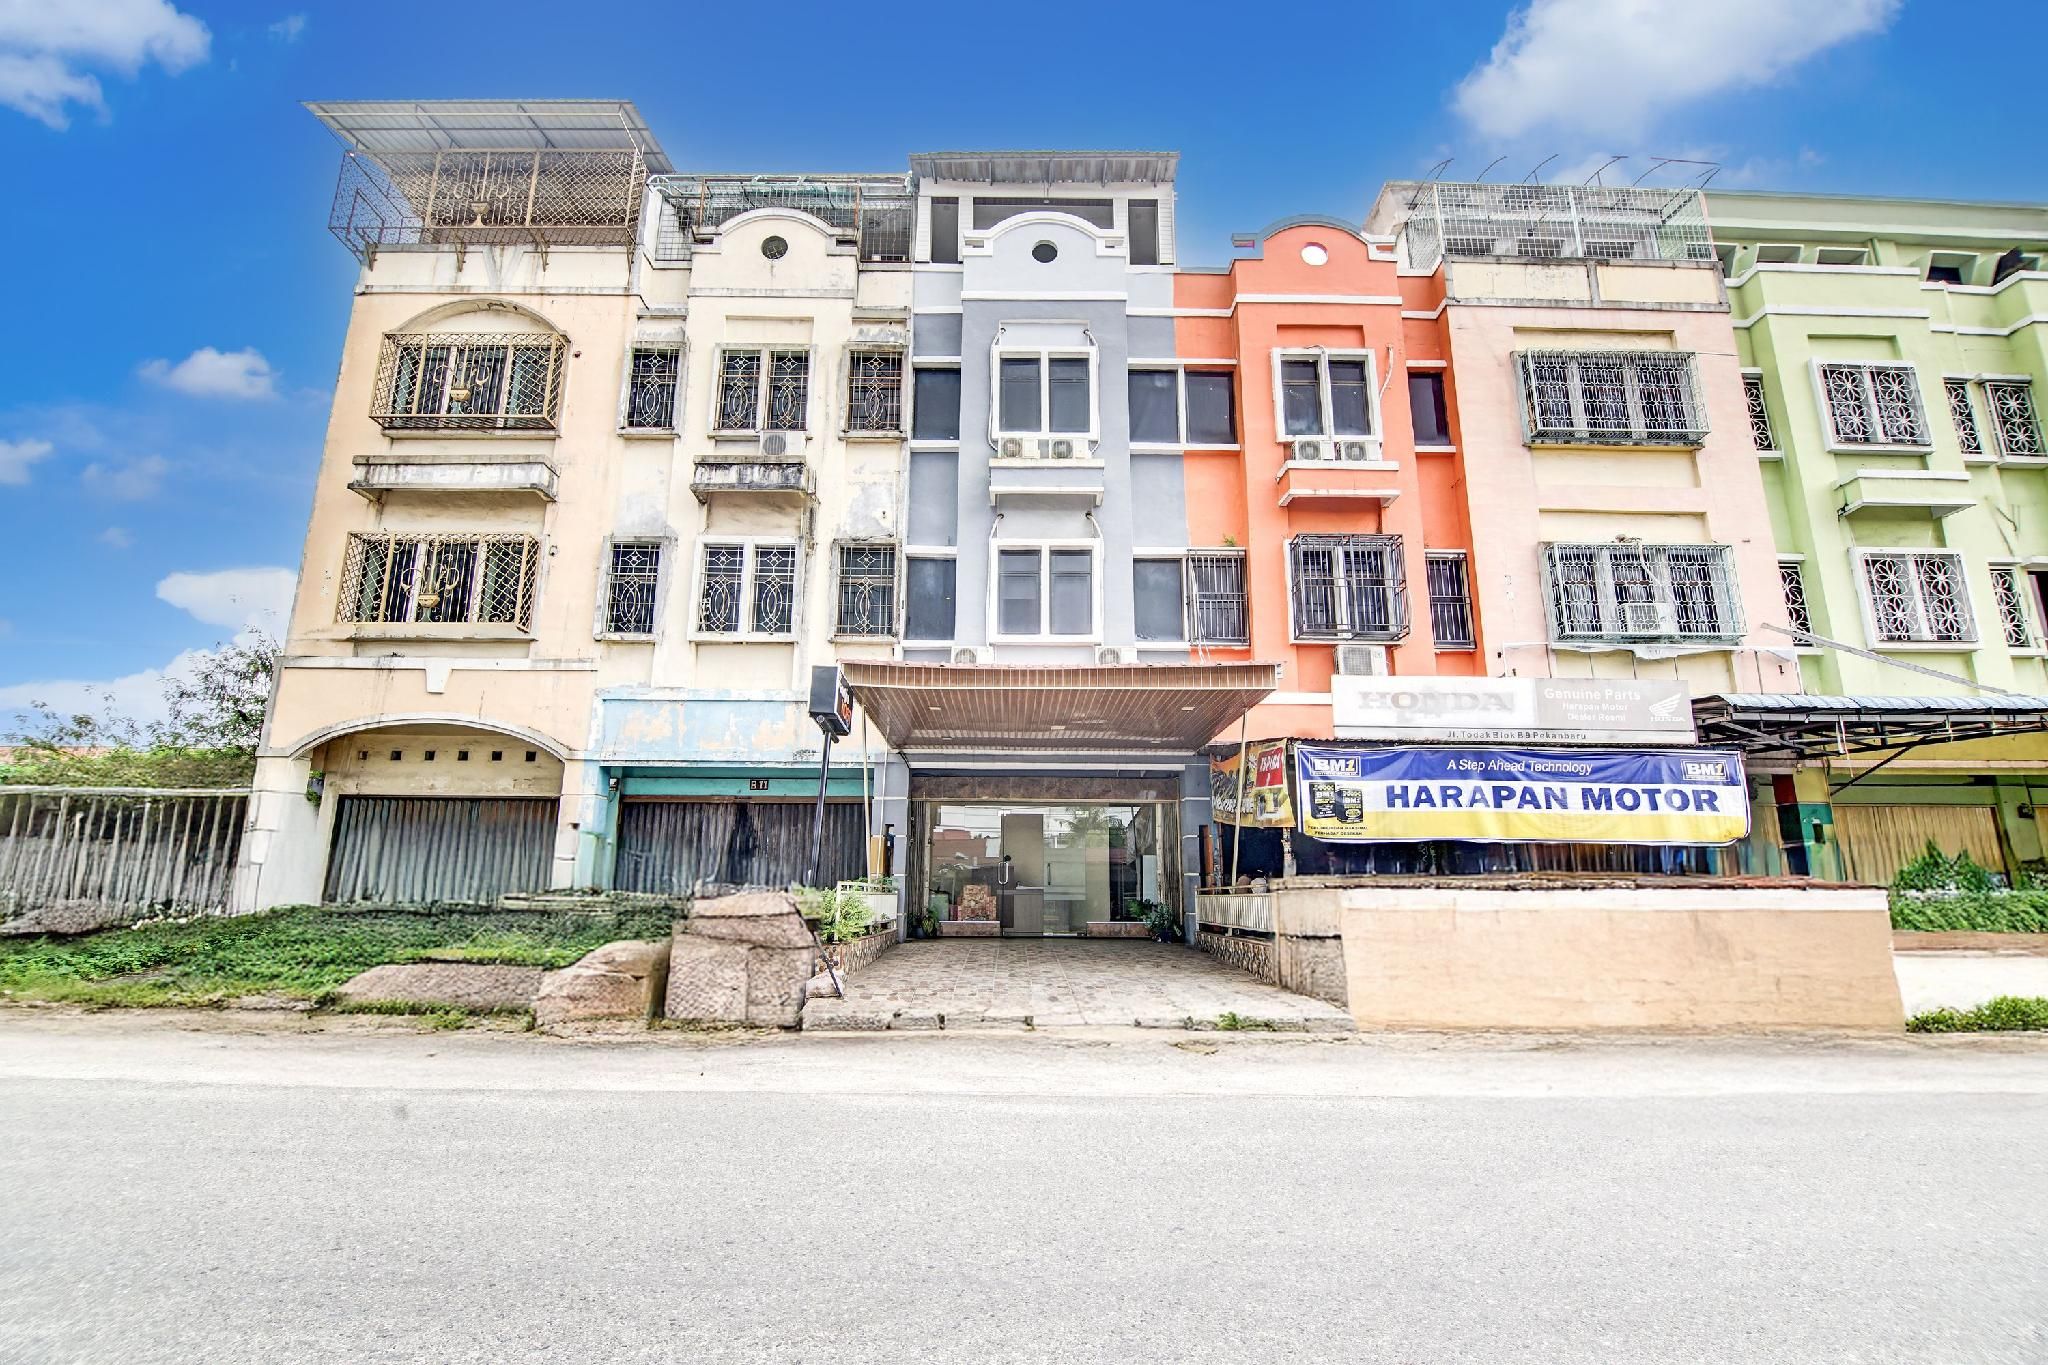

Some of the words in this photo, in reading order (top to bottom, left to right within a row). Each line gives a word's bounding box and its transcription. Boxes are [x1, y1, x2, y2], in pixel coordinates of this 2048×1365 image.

[1358, 691, 1515, 711] HONDA
[1544, 688, 1601, 700] Genuine
[1605, 689, 1641, 701] Parts
[1314, 758, 1355, 772] BM1
[1447, 759, 1457, 770] A
[1459, 759, 1485, 773] Step
[1488, 759, 1525, 772] Ahead
[1529, 760, 1593, 775] Technology
[1686, 763, 1724, 776] BM1
[1386, 785, 1569, 810] HARAPAN
[1581, 787, 1720, 812] MOTOR
